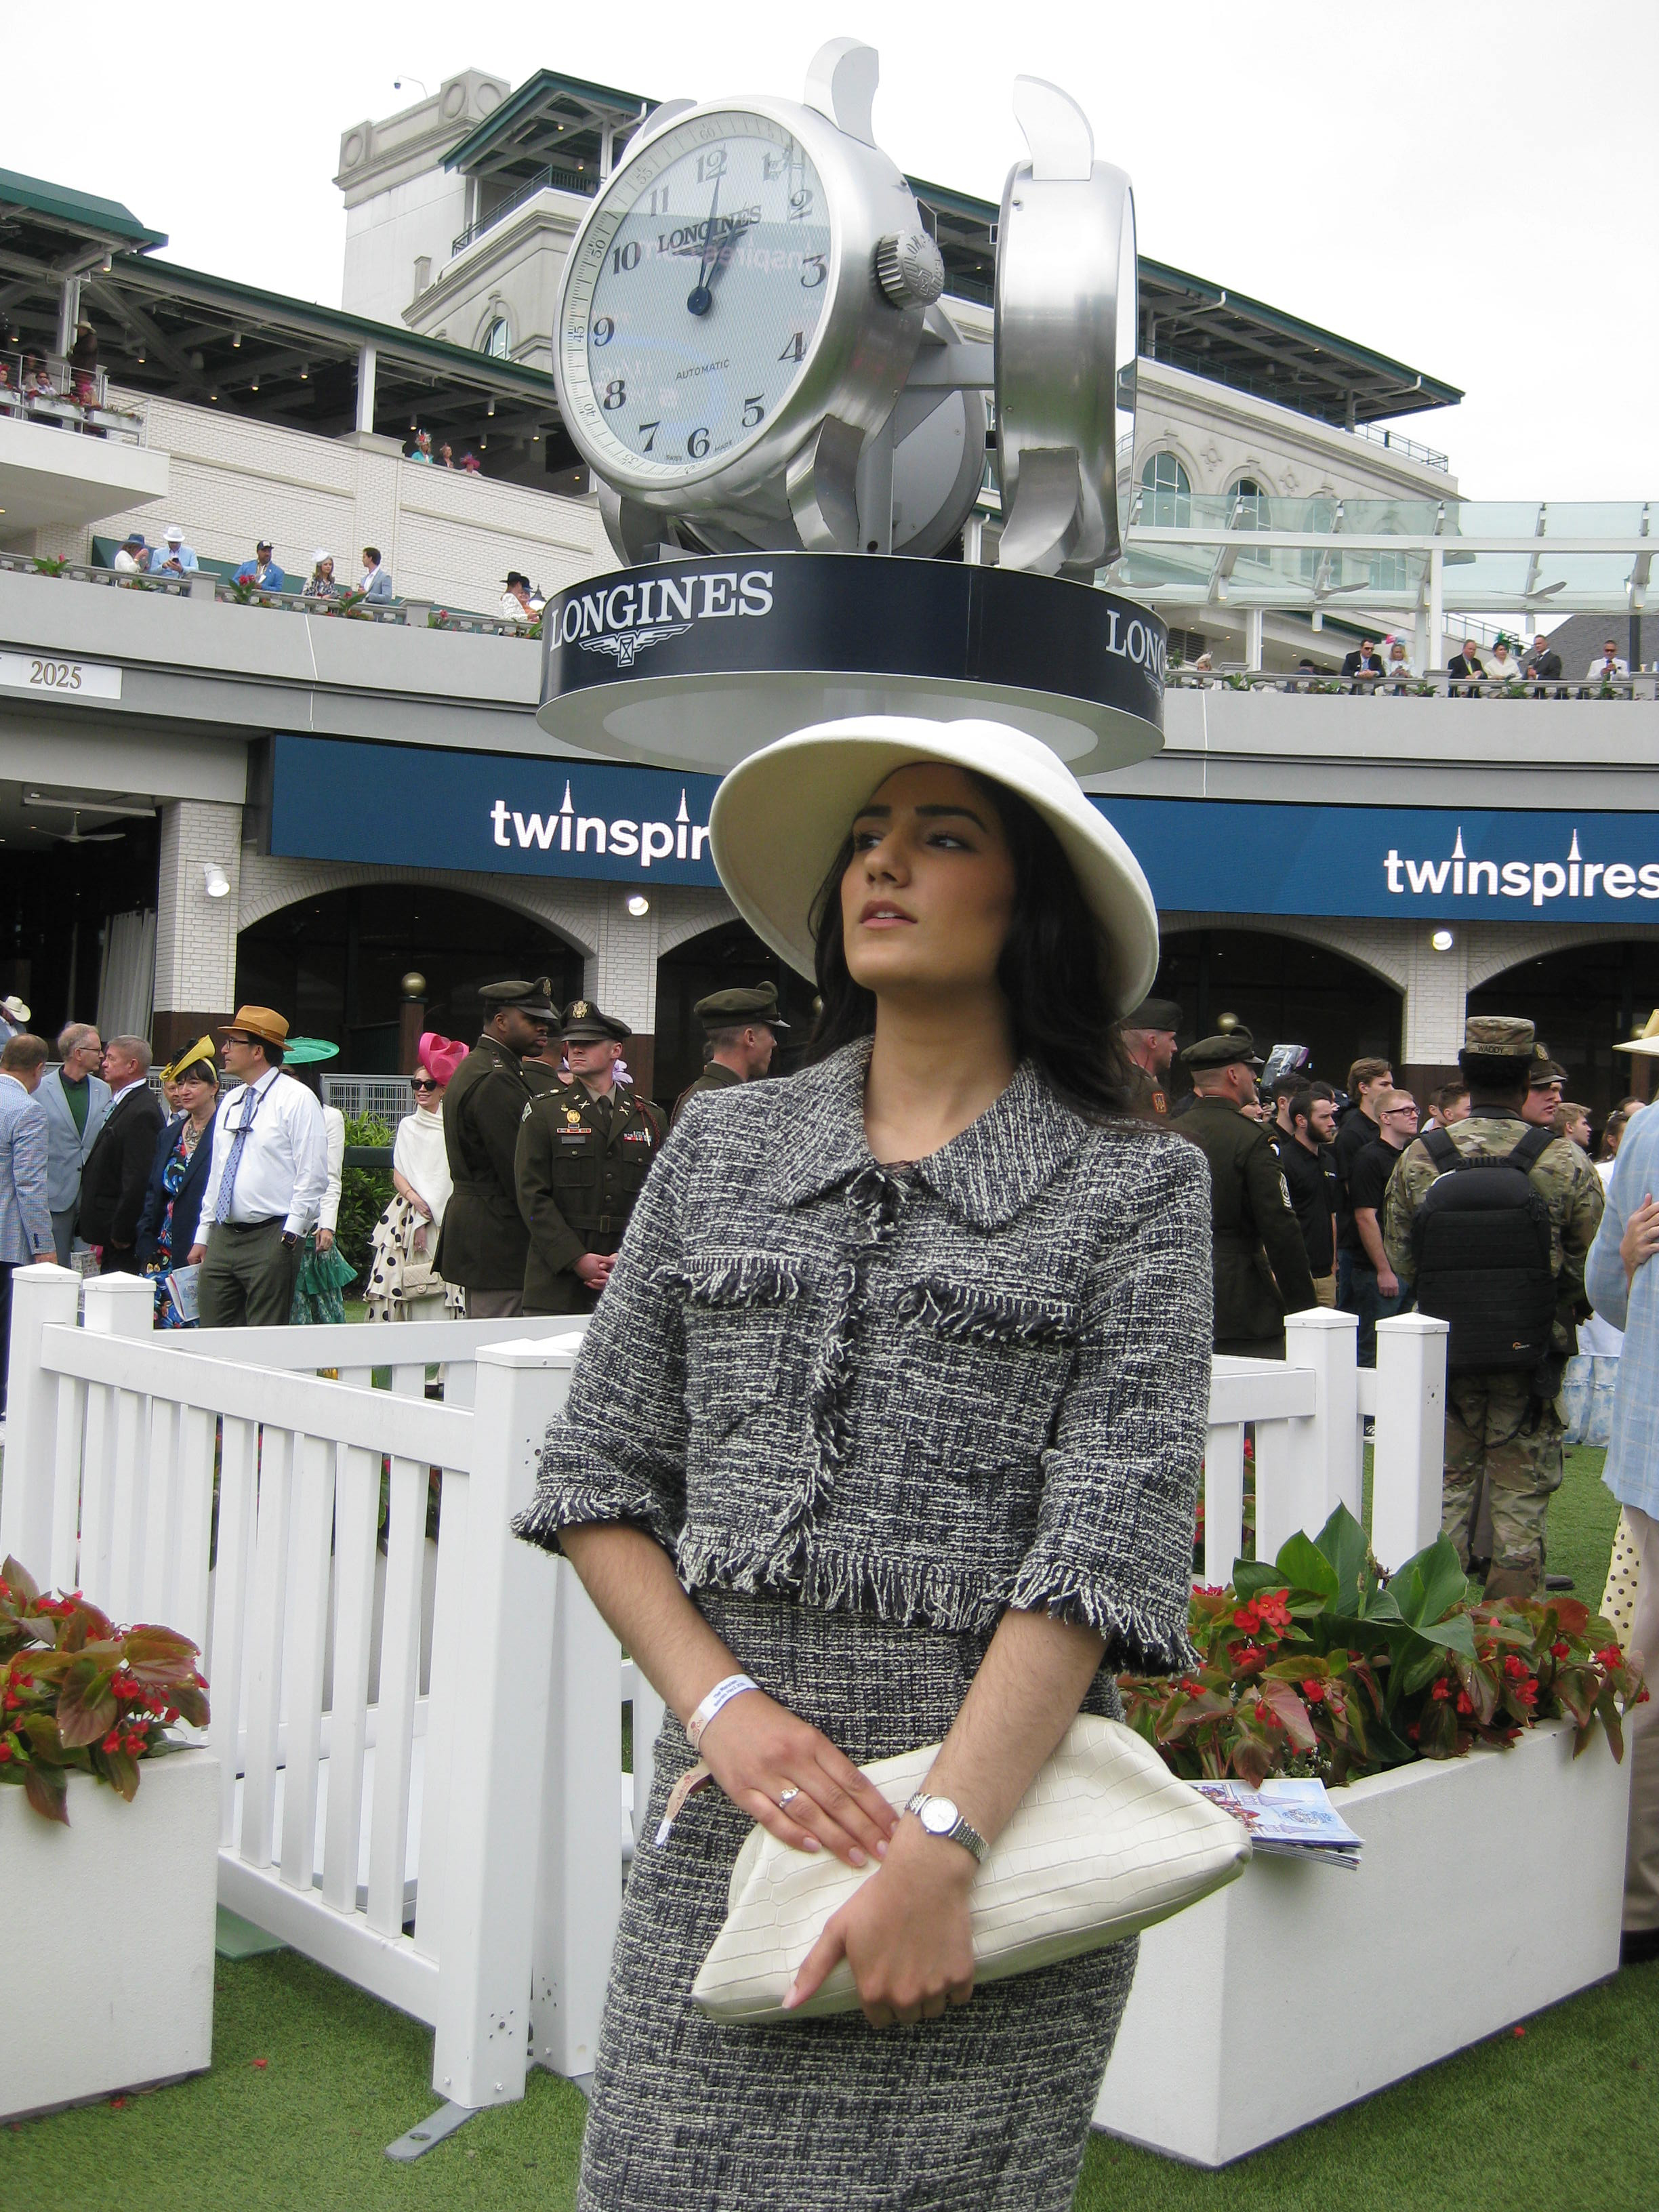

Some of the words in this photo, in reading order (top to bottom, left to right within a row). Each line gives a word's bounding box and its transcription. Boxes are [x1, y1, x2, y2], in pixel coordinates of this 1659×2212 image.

[696, 150, 728, 184] 12
[649, 185, 669, 217] 11
[789, 189, 813, 221] 2
[657, 204, 762, 253] LONGNES
[590, 239, 607, 259] 50
[613, 241, 641, 275] 10
[800, 253, 827, 288] 3
[574, 325, 585, 343] 45
[593, 316, 615, 347] 9
[779, 331, 807, 363] 4
[675, 358, 730, 381] AUTOMATIC
[603, 380, 626, 410] 8
[741, 393, 765, 428] 5
[638, 420, 661, 453] 7
[687, 428, 710, 459] 6
[550, 570, 774, 653] LONGINES
[30, 660, 82, 690] 2025
[1383, 825, 1659, 907] twinspires
[1477, 1045, 1504, 1054] WADDY
